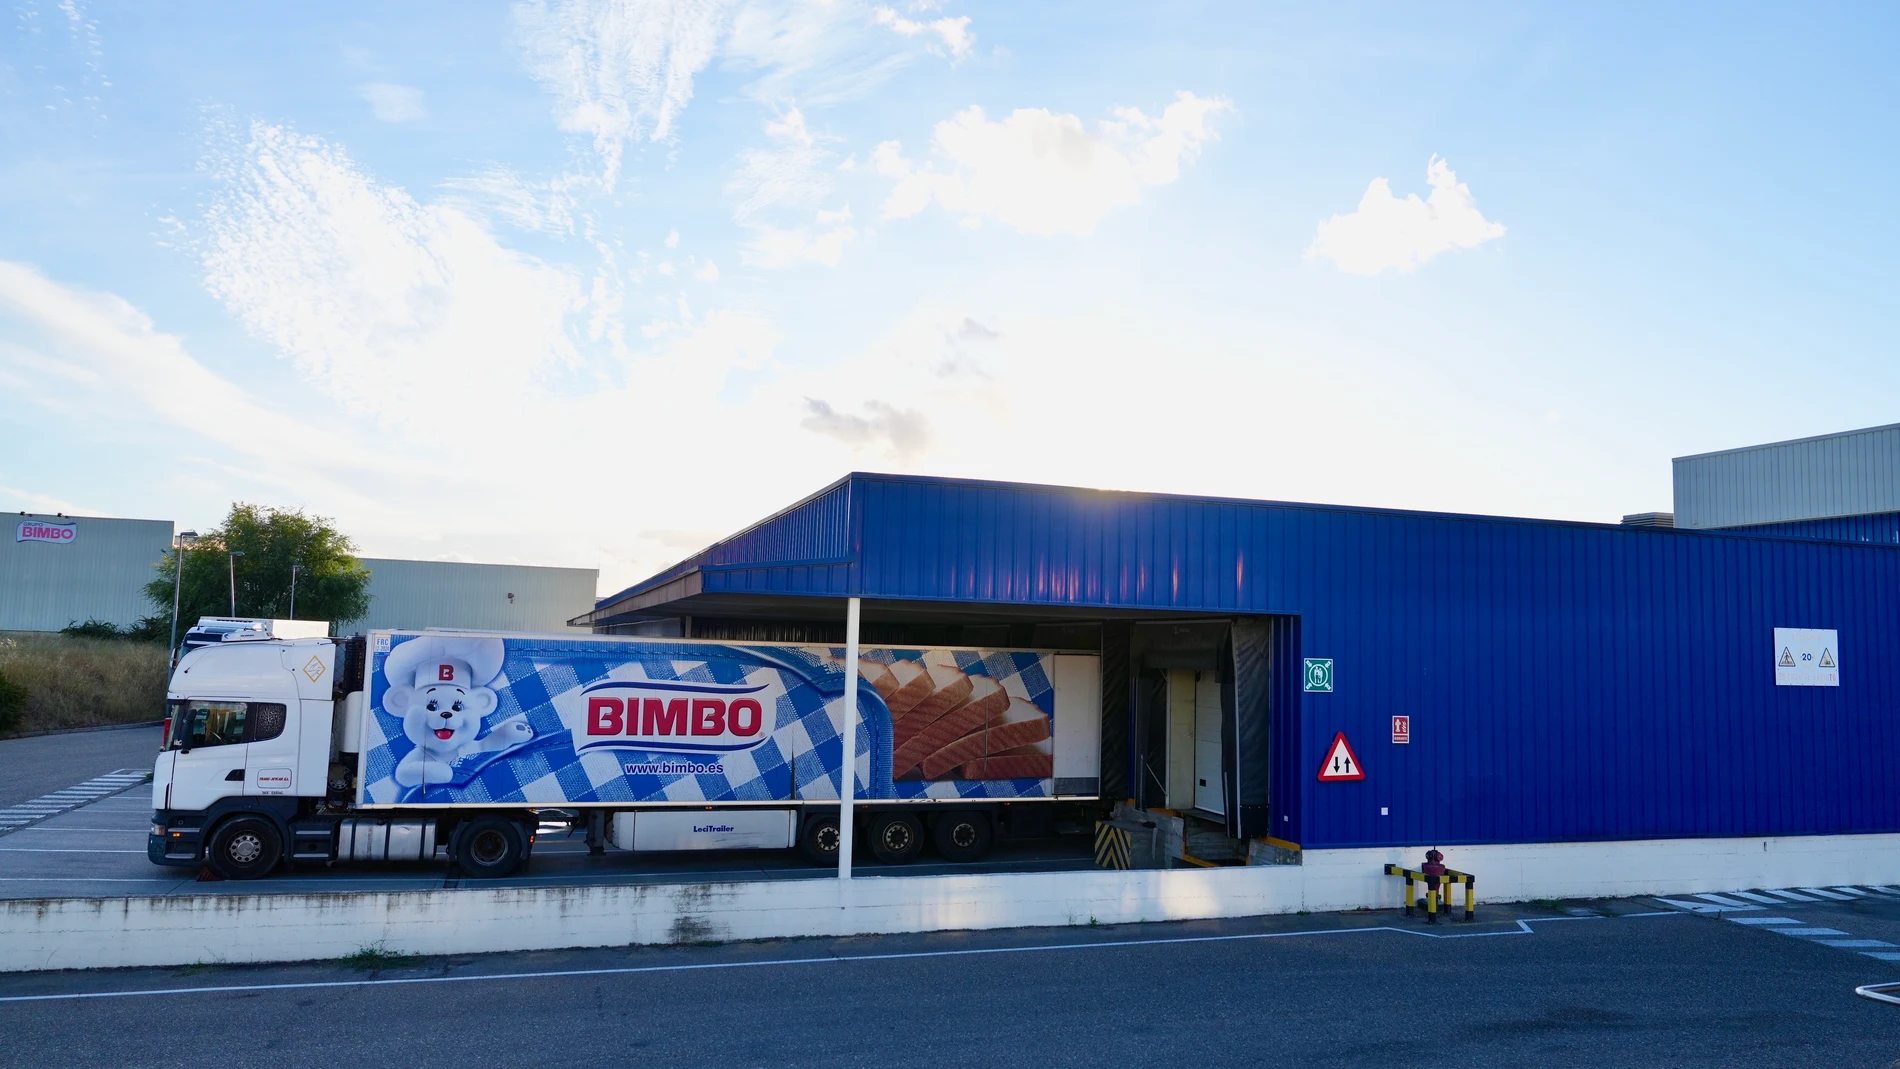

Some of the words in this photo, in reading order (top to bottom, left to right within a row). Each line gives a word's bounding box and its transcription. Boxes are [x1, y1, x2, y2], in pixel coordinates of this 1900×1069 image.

[22, 526, 73, 539] BIMBO
[1801, 653, 1812, 661] 20
[439, 664, 454, 681] B
[587, 697, 762, 737] BIMBO
[625, 762, 724, 774] www.bimbo.es
